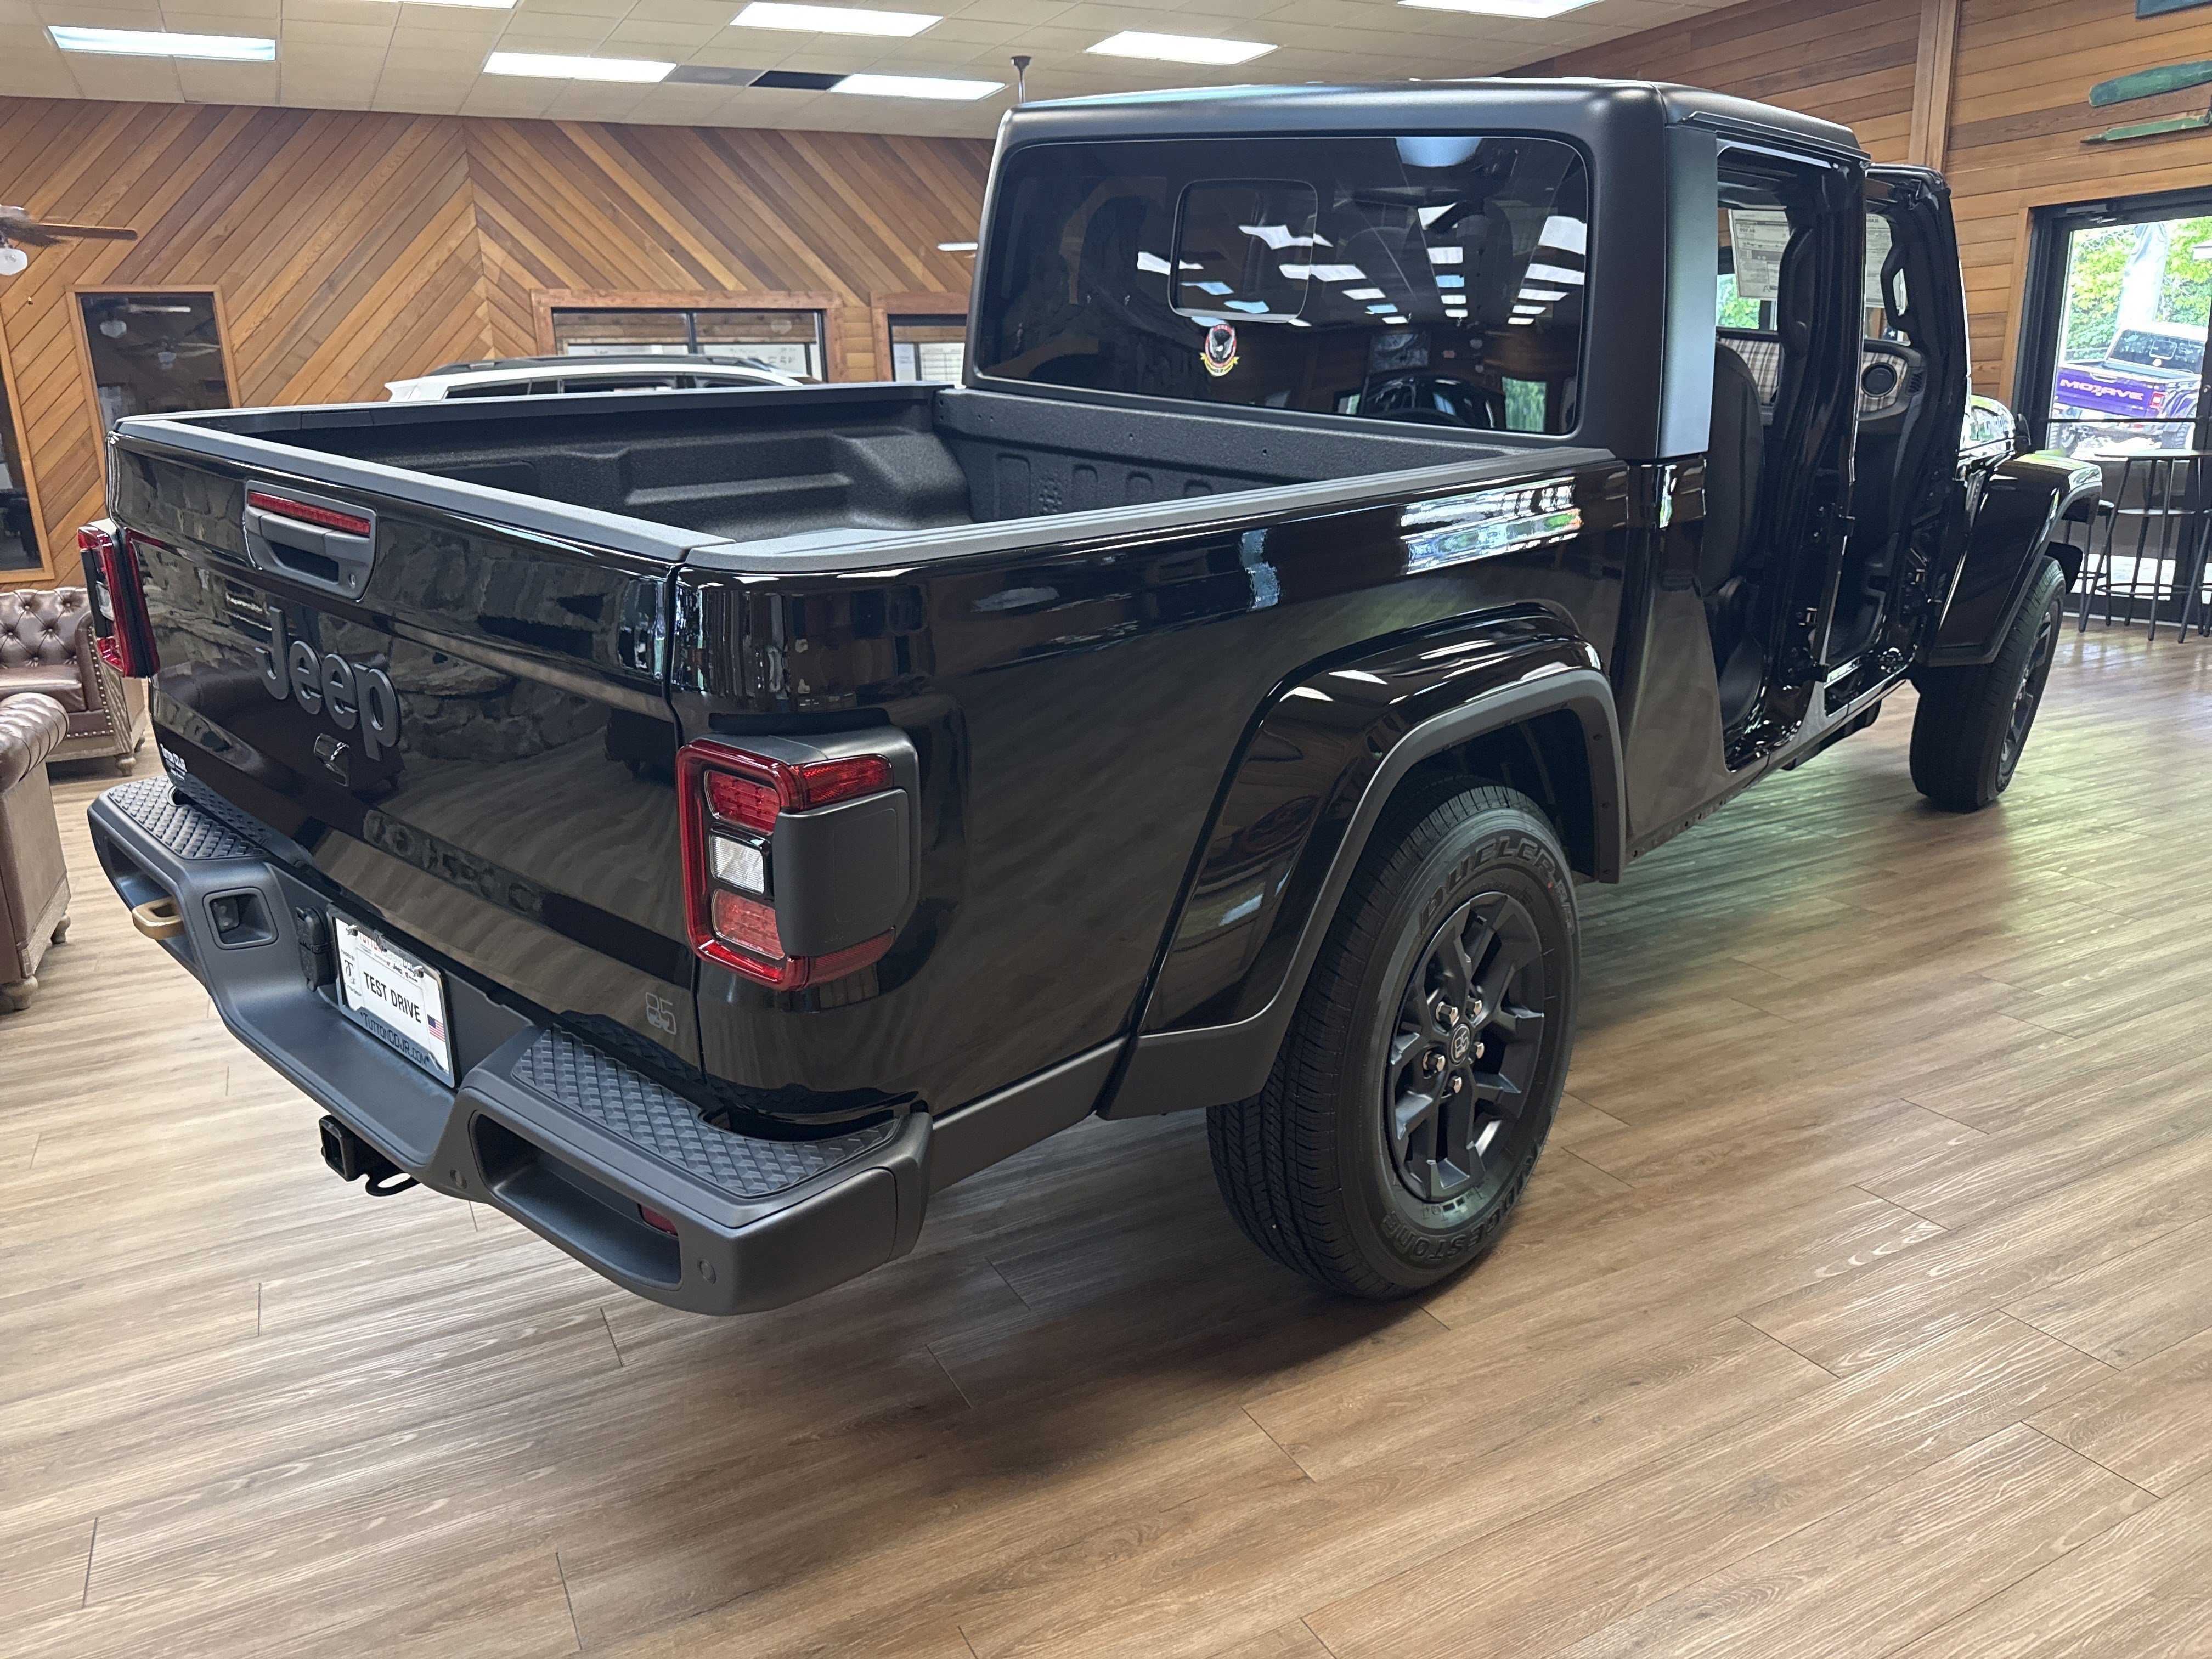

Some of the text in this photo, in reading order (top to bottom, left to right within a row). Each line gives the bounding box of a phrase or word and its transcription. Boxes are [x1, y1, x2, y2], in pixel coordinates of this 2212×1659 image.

[2059, 379, 2145, 401] MOJAVE
[255, 607, 401, 761] Jeep
[363, 972, 387, 1001] TEST
[390, 989, 421, 1024] DRIVE
